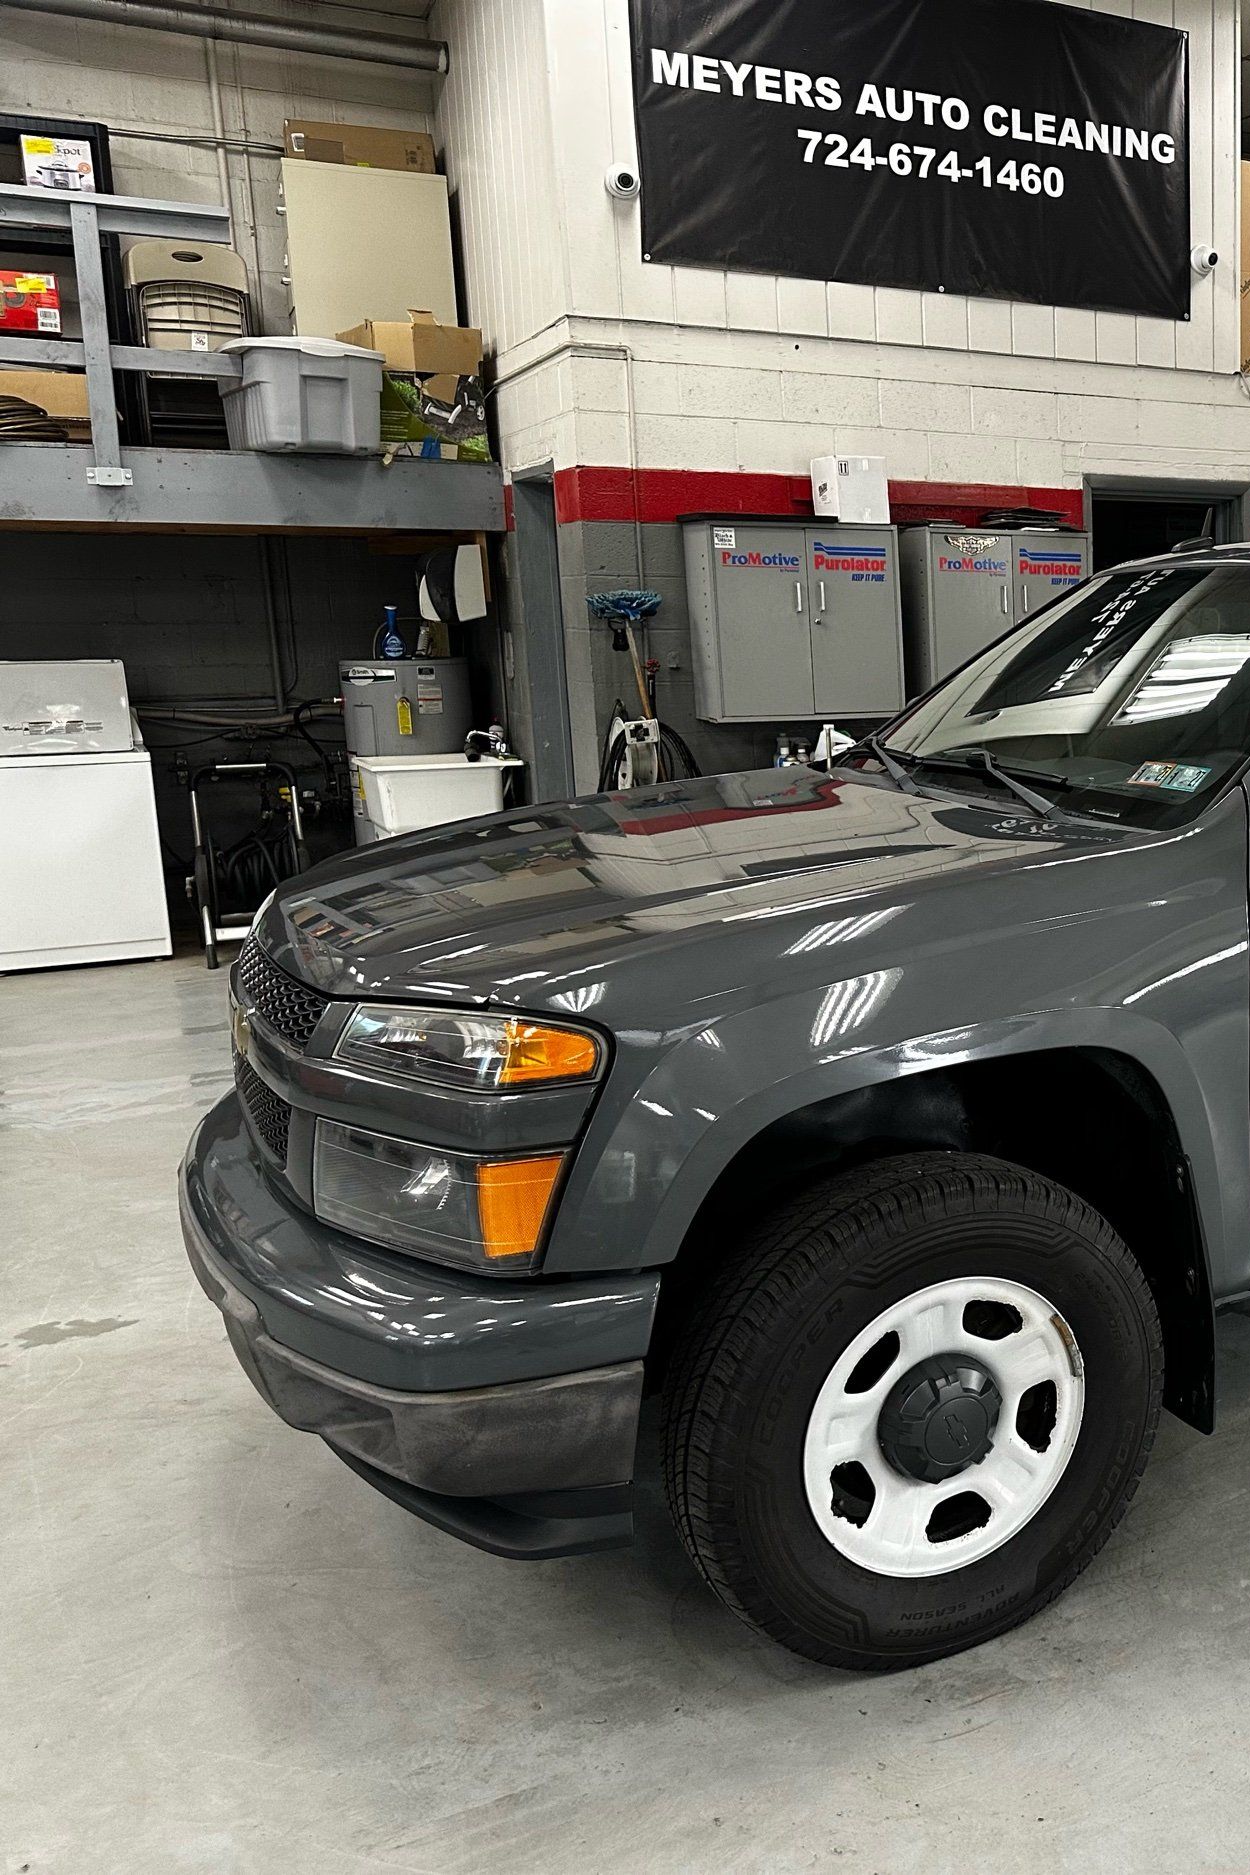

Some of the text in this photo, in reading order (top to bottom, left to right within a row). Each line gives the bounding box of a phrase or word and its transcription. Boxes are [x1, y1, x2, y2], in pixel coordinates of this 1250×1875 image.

[651, 48, 1176, 164] MEYERS AUTO CLEANING
[797, 128, 1064, 197] 724-674-1460
[722, 551, 799, 566] ProMotive
[814, 554, 886, 571] Purolator
[938, 556, 1006, 571] ProMotive
[1019, 560, 1081, 575] Purolator
[900, 1602, 967, 1621] SEASON
